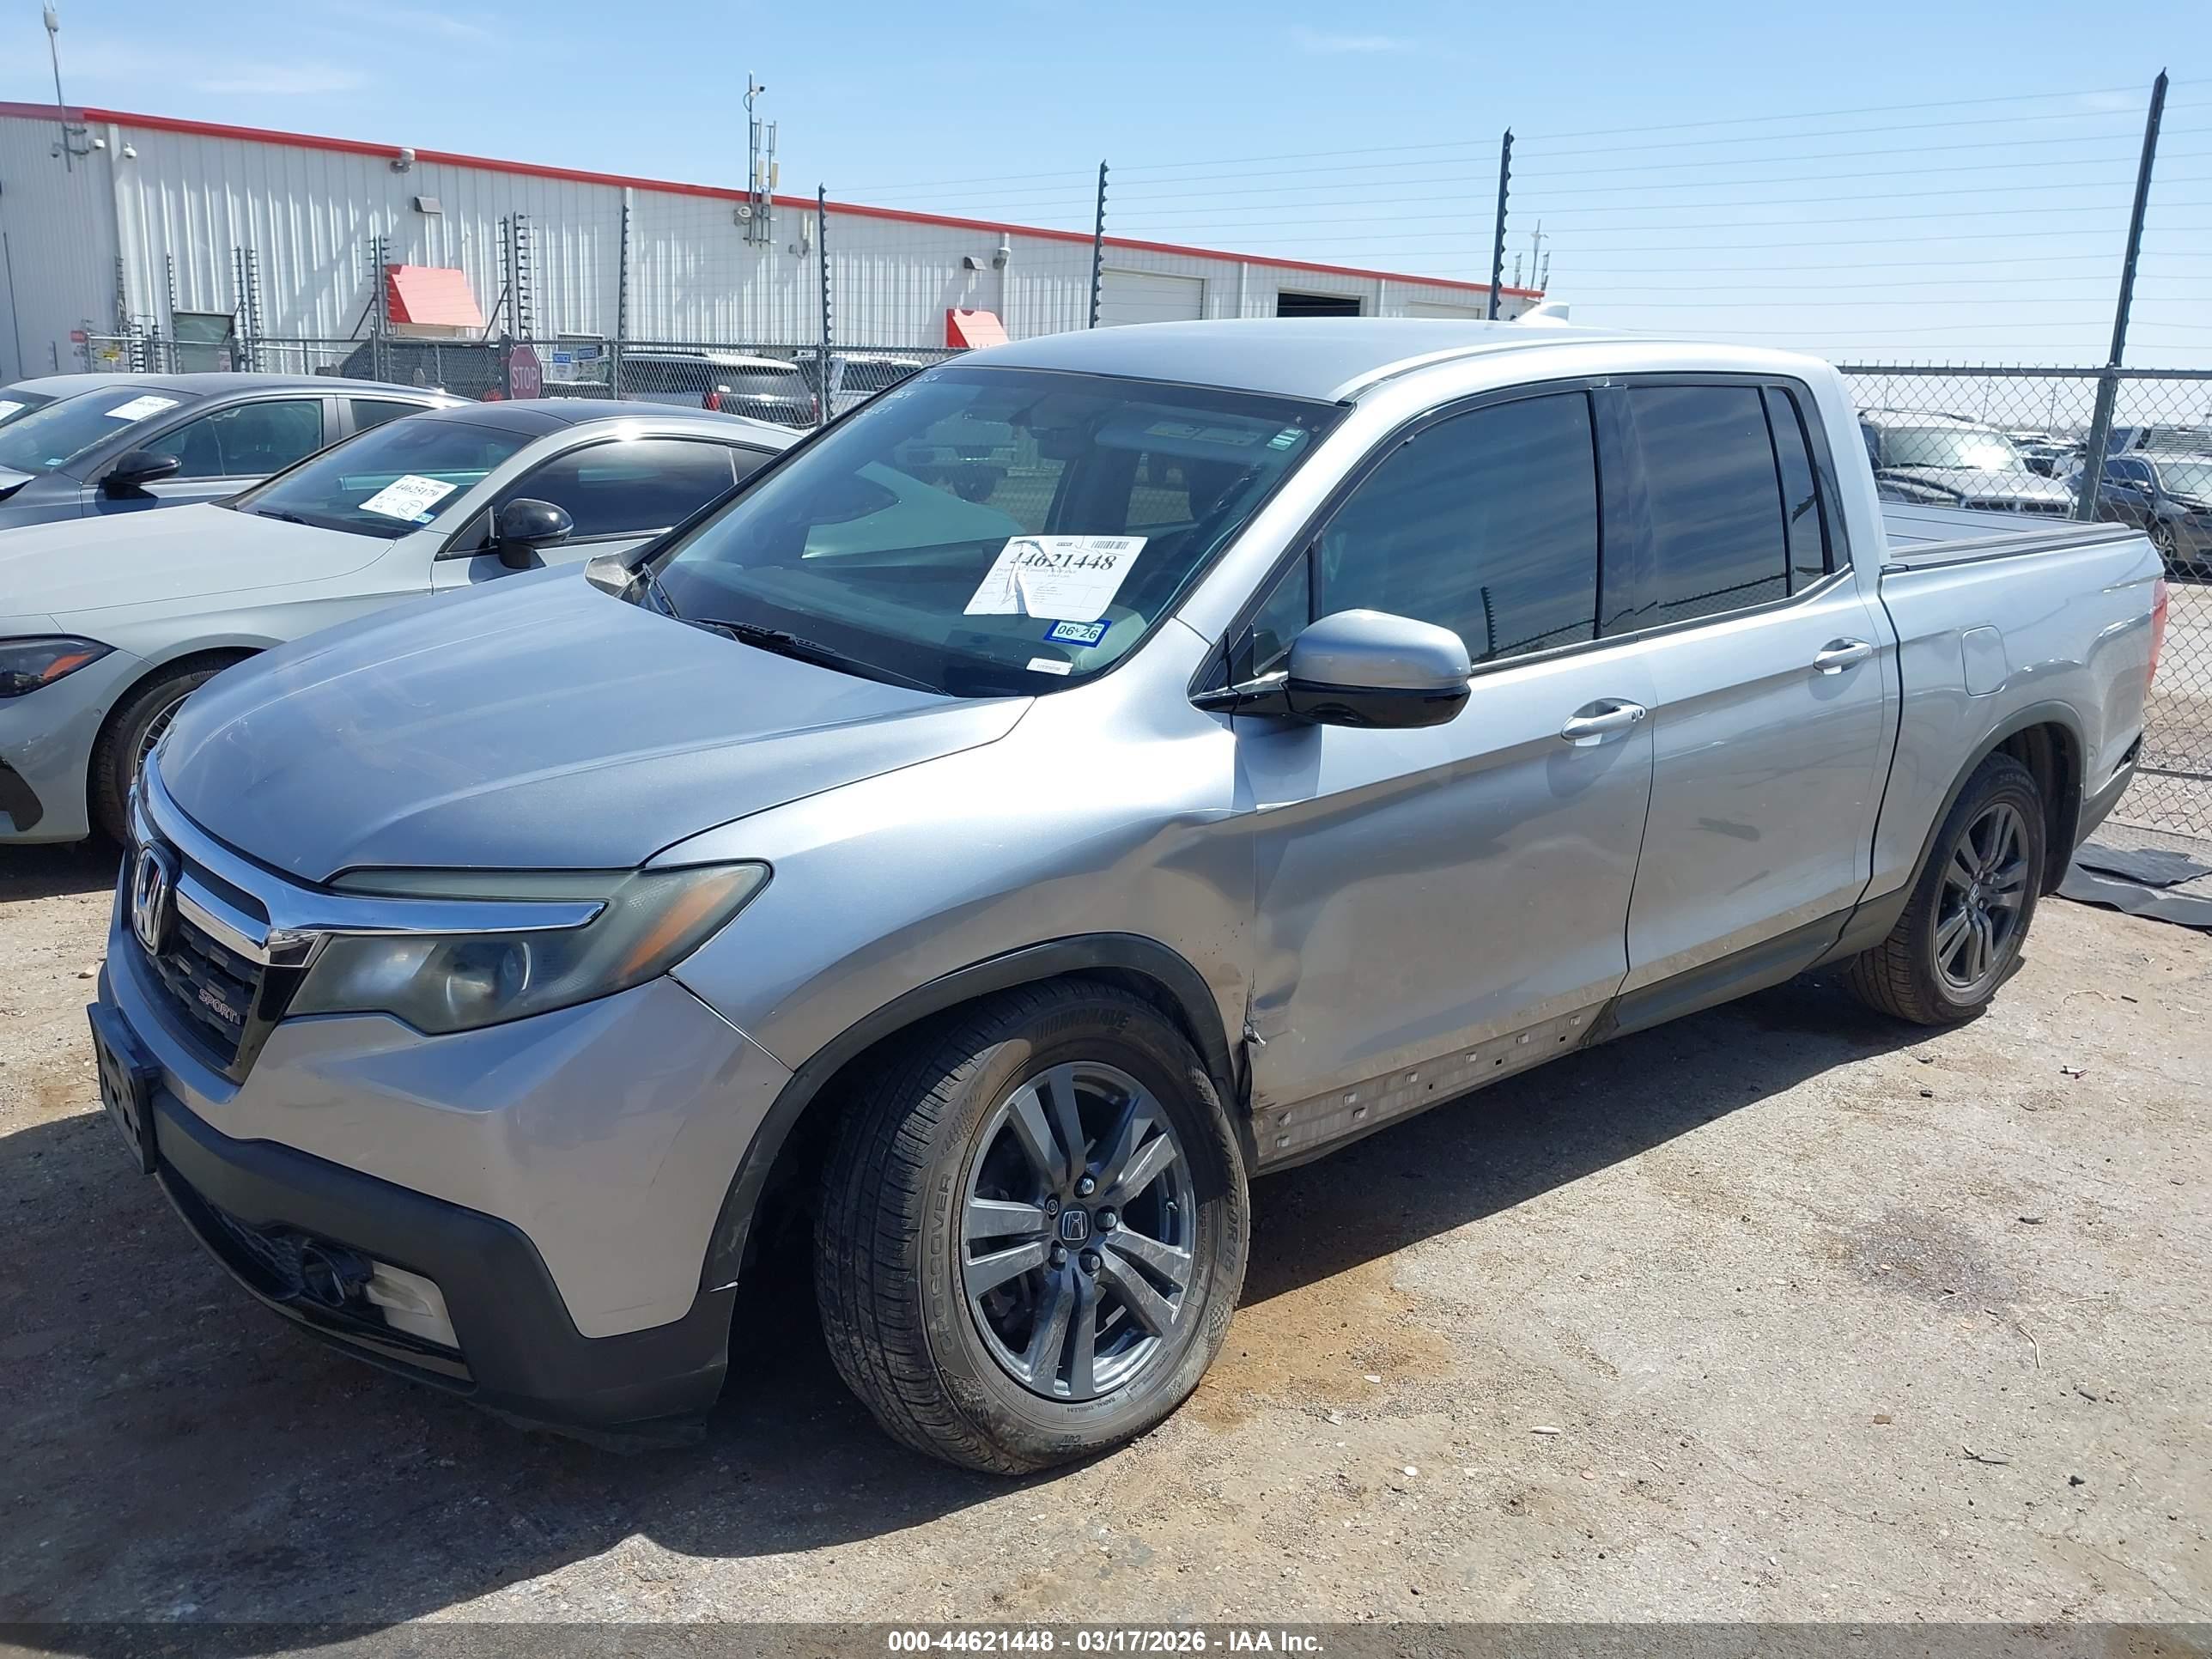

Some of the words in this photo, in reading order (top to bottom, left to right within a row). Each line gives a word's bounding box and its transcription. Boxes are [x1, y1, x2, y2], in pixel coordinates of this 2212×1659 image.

[512, 367, 538, 390] STOP
[1010, 552, 1117, 571] 44621448
[1057, 625, 1076, 636] 06
[1079, 628, 1098, 639] 26
[198, 988, 238, 1023] SPORT
[930, 1173, 953, 1356] CROSSOVER
